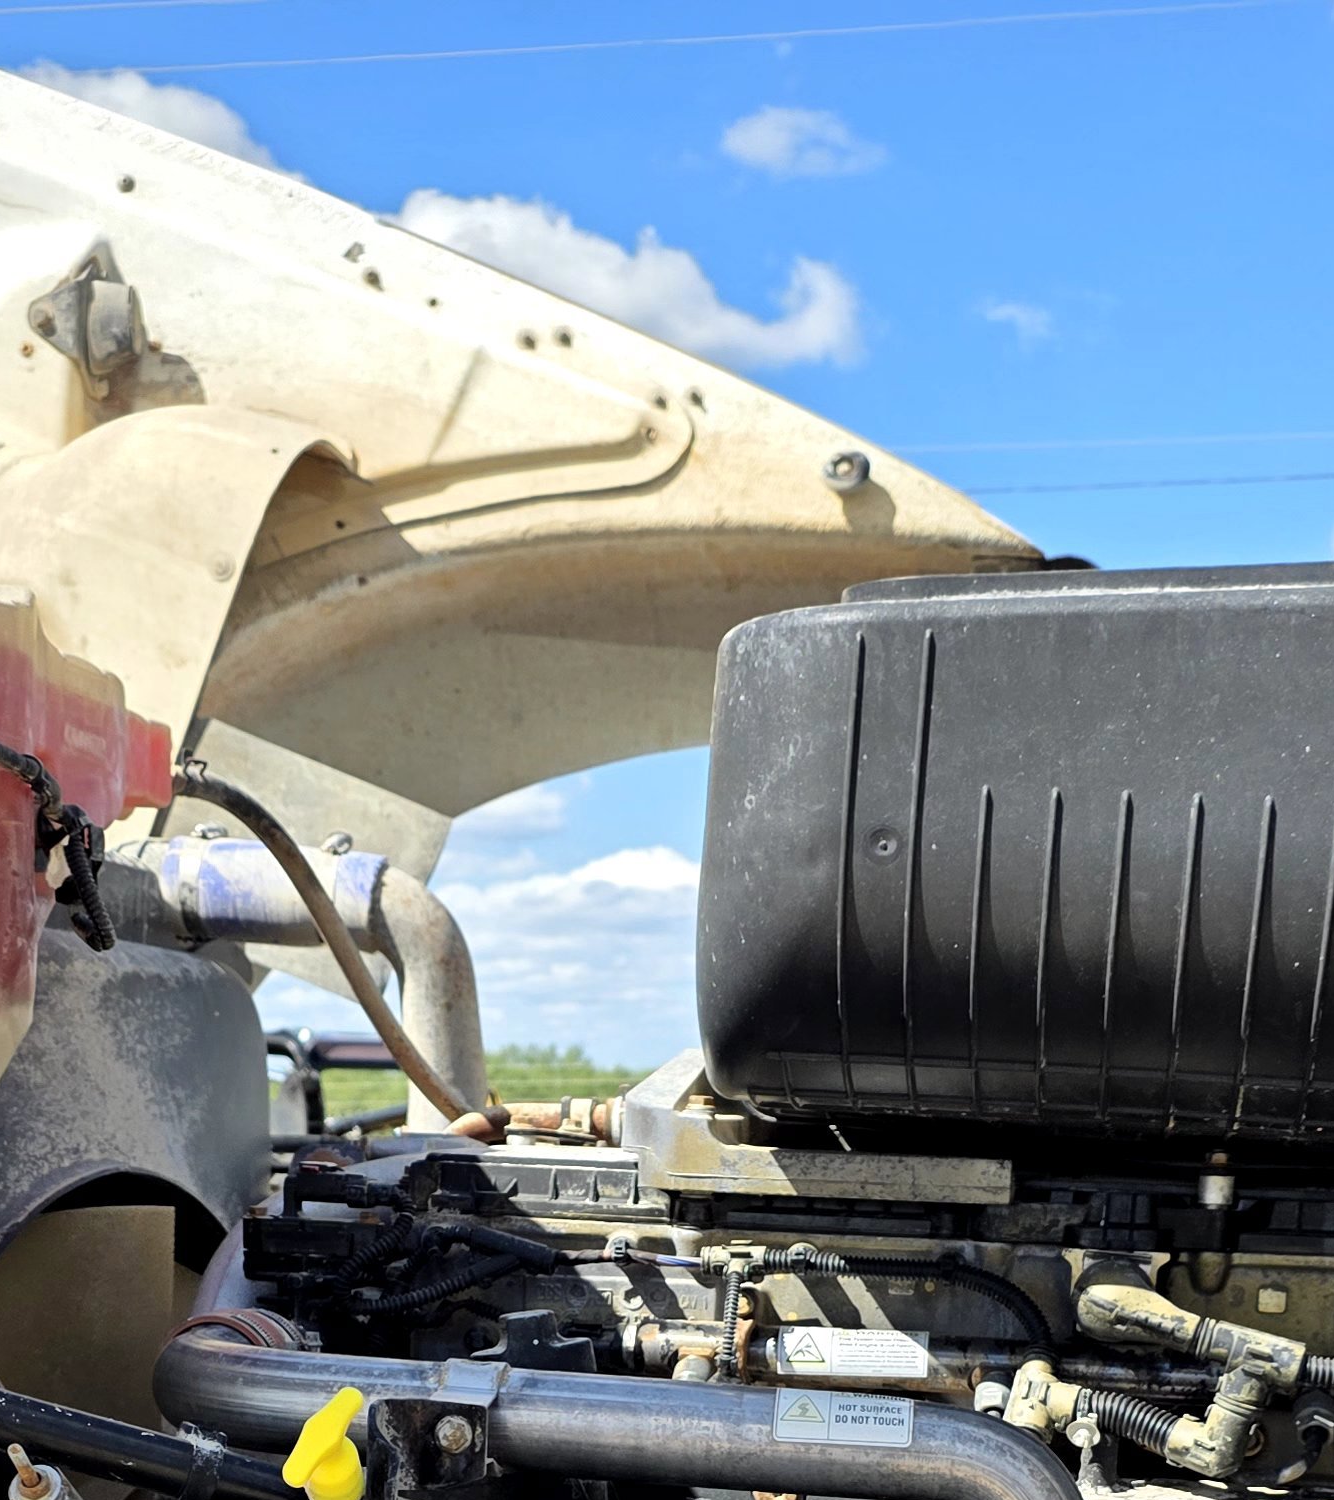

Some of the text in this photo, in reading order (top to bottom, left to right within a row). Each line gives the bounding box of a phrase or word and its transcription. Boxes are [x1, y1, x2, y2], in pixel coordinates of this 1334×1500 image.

[838, 1404, 902, 1415] HOT SURFACE
[835, 1414, 904, 1427] DO NOT TOUCH
